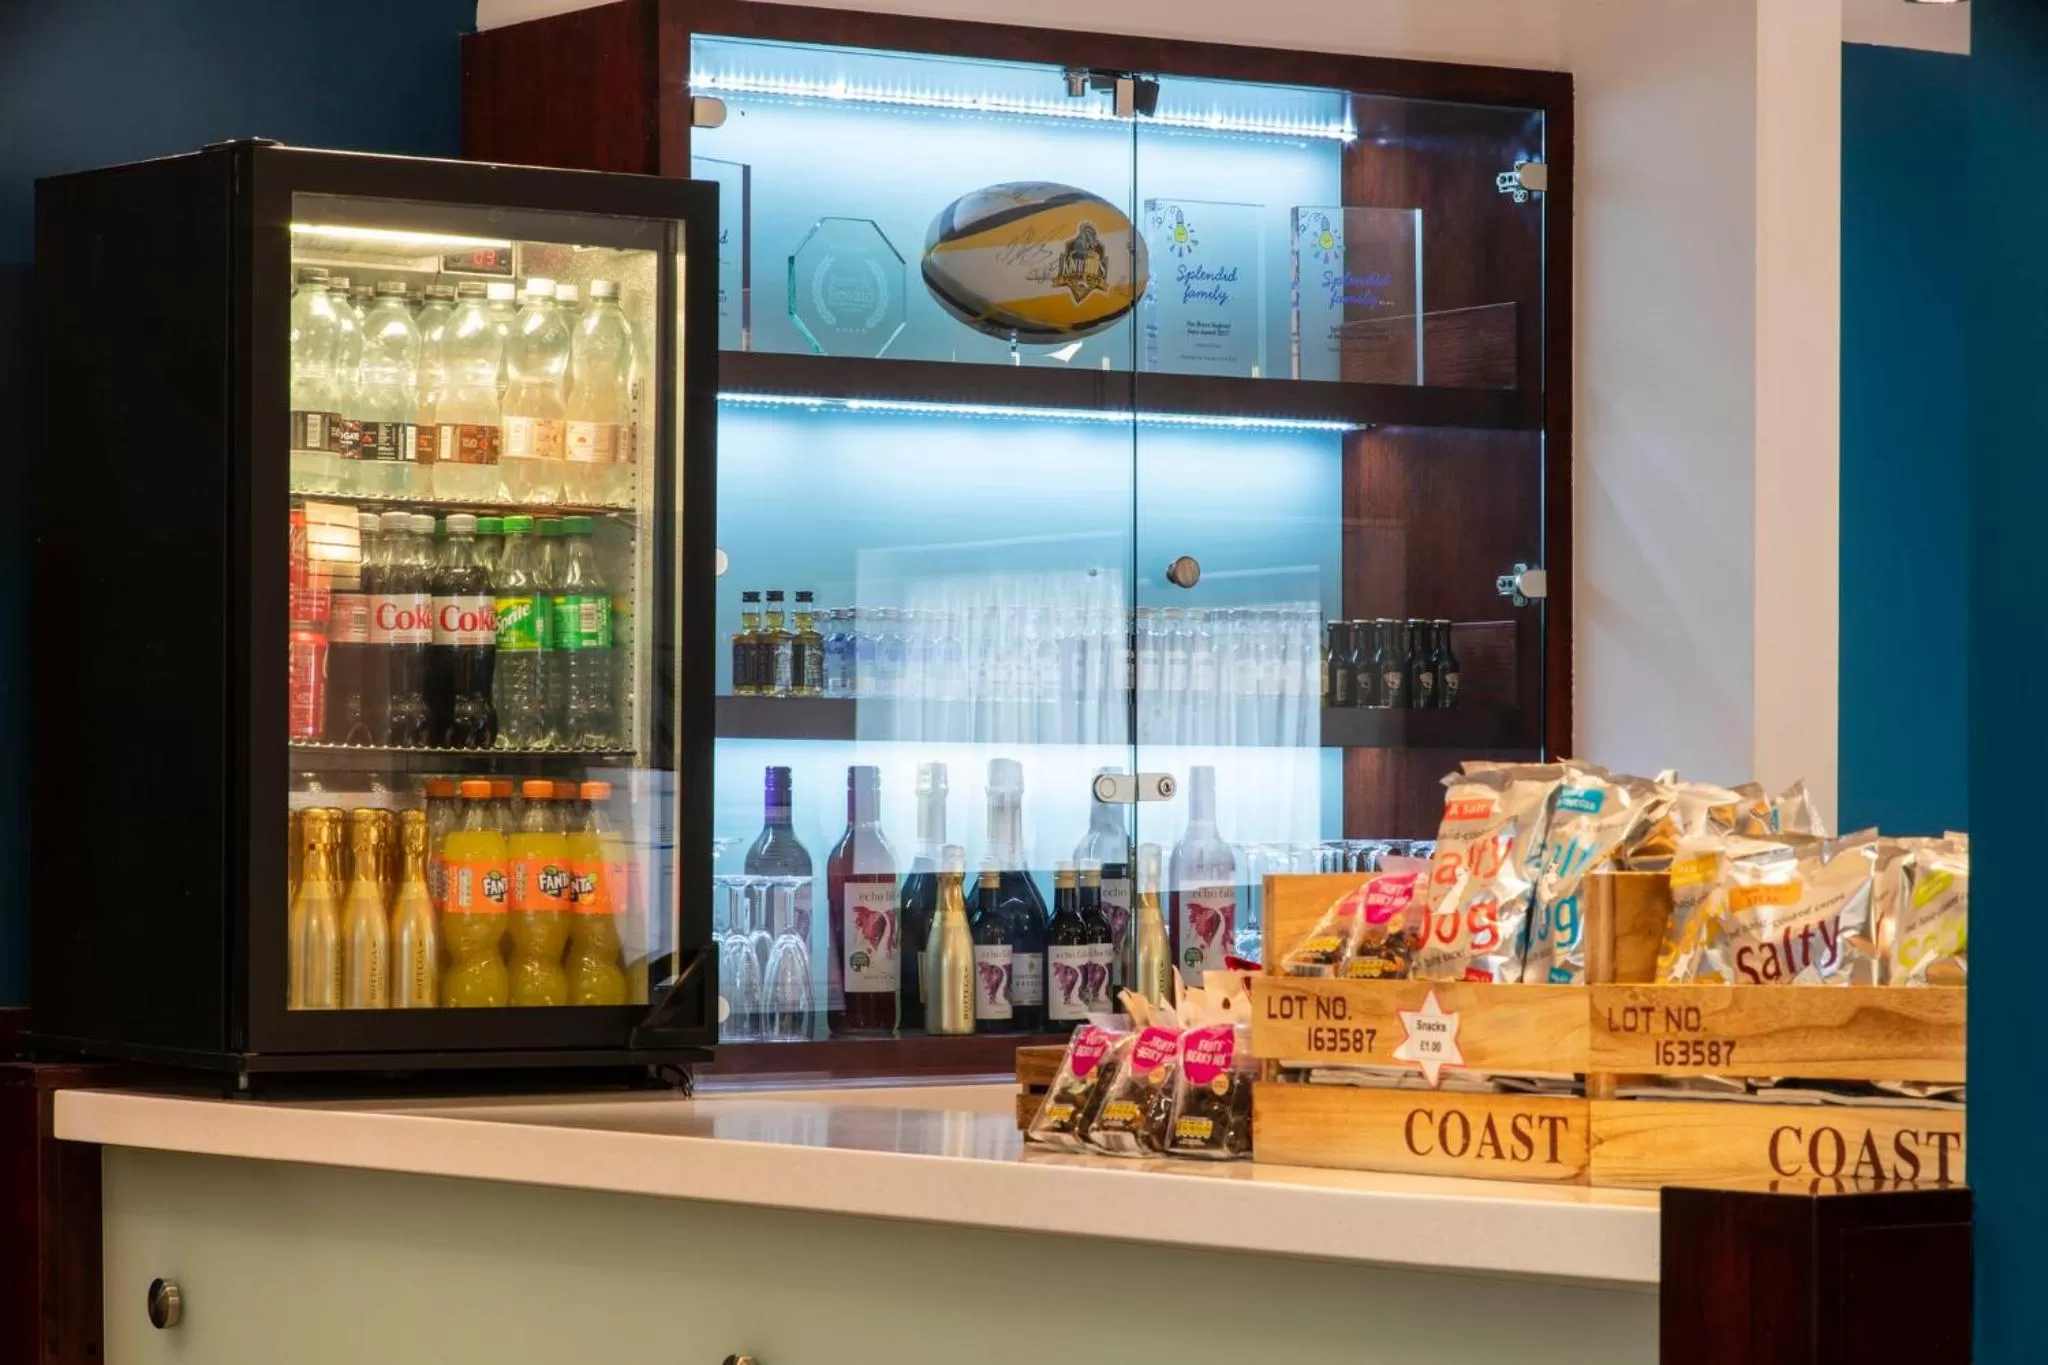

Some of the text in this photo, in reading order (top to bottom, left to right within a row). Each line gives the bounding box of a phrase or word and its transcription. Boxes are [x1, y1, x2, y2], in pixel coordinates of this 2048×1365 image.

[1177, 264, 1238, 286] Splendid
[1183, 284, 1229, 306] family
[495, 603, 531, 635] Sprite
[1433, 837, 1513, 885] alty
[1102, 887, 1128, 902] echo
[1736, 915, 1841, 984] salty
[1267, 995, 1352, 1021] LOT NO.
[1608, 1006, 1707, 1033] LOT NO.
[1416, 1019, 1446, 1032] Snacks
[1198, 1038, 1227, 1051] FRUITY
[1307, 1027, 1377, 1054] 163587
[1420, 1040, 1442, 1053] £1.00
[1655, 1040, 1737, 1067] 163587
[1184, 1049, 1212, 1065] BERRY
[1404, 1108, 1569, 1164] COAST
[1768, 1124, 1962, 1185] COAST
